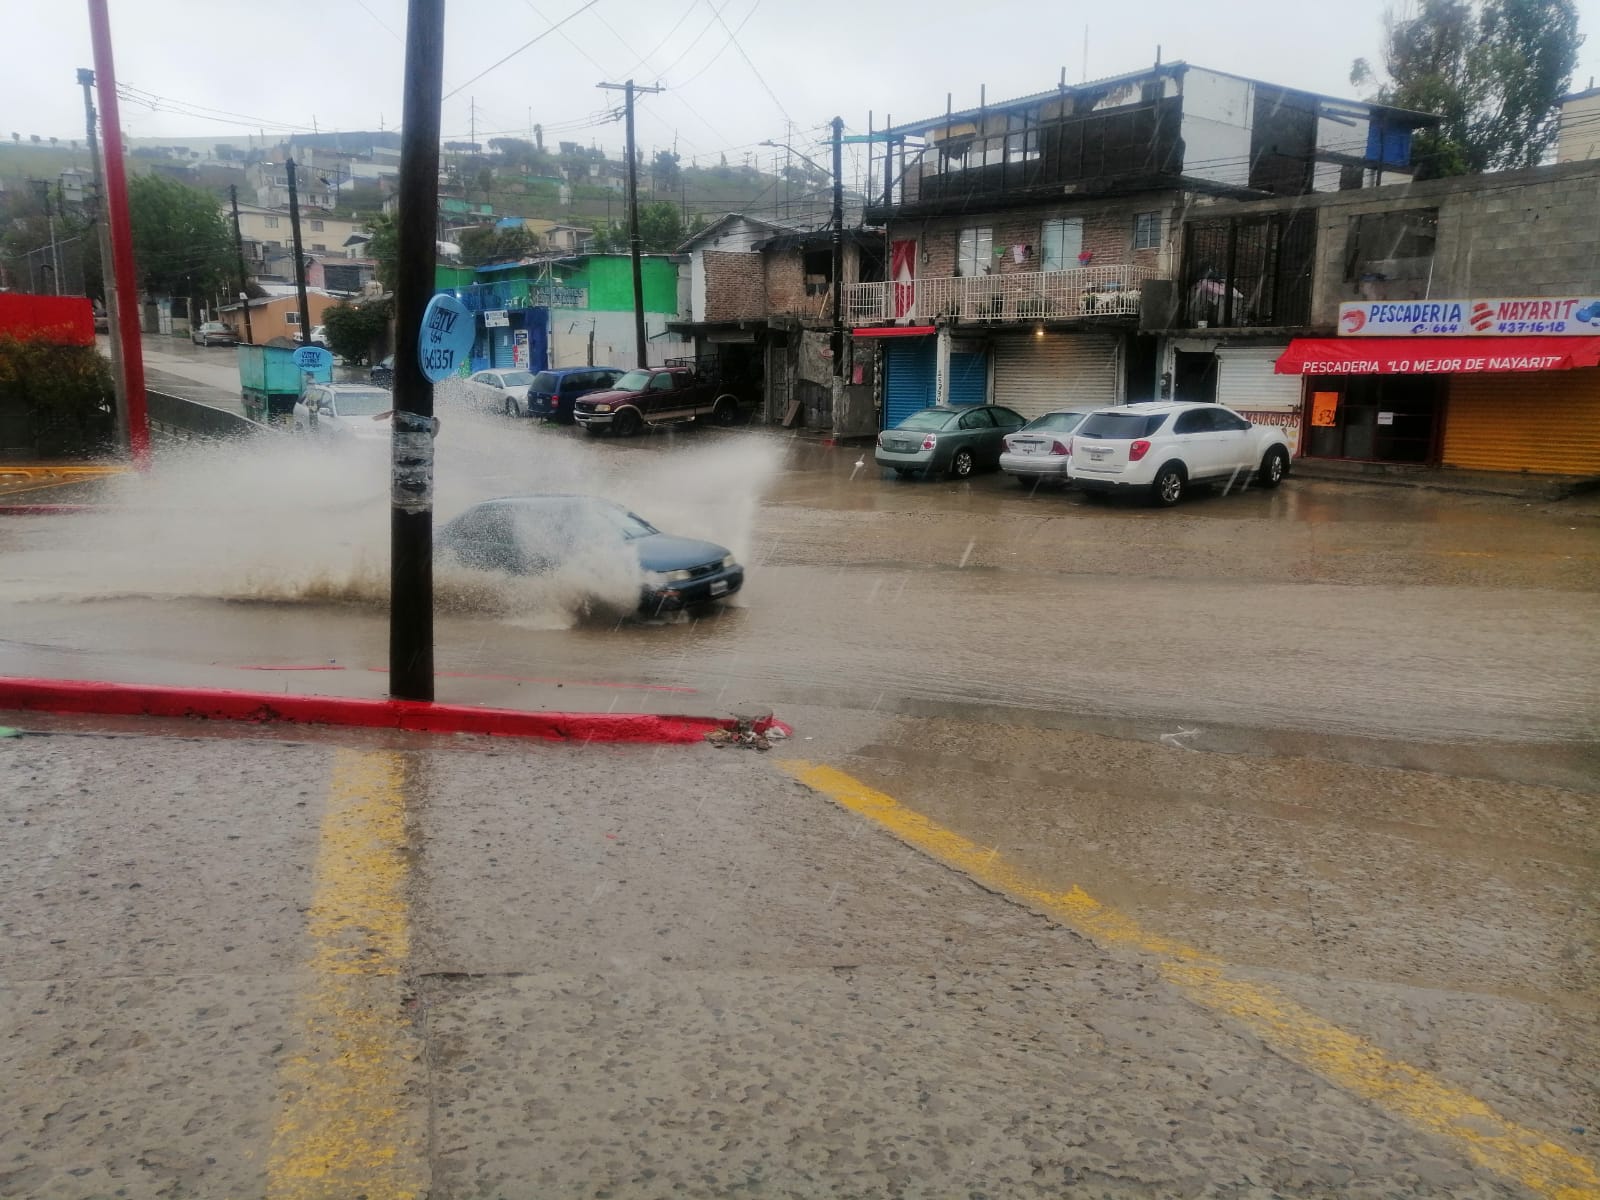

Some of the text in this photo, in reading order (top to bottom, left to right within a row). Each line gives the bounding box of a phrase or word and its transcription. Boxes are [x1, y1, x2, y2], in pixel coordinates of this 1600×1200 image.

[1369, 299, 1579, 323] PESCADERIA NAYARIT
[1302, 361, 1379, 373] PESCADERIA
[1413, 359, 1462, 372] MEJOR
[1464, 358, 1485, 370] DE
